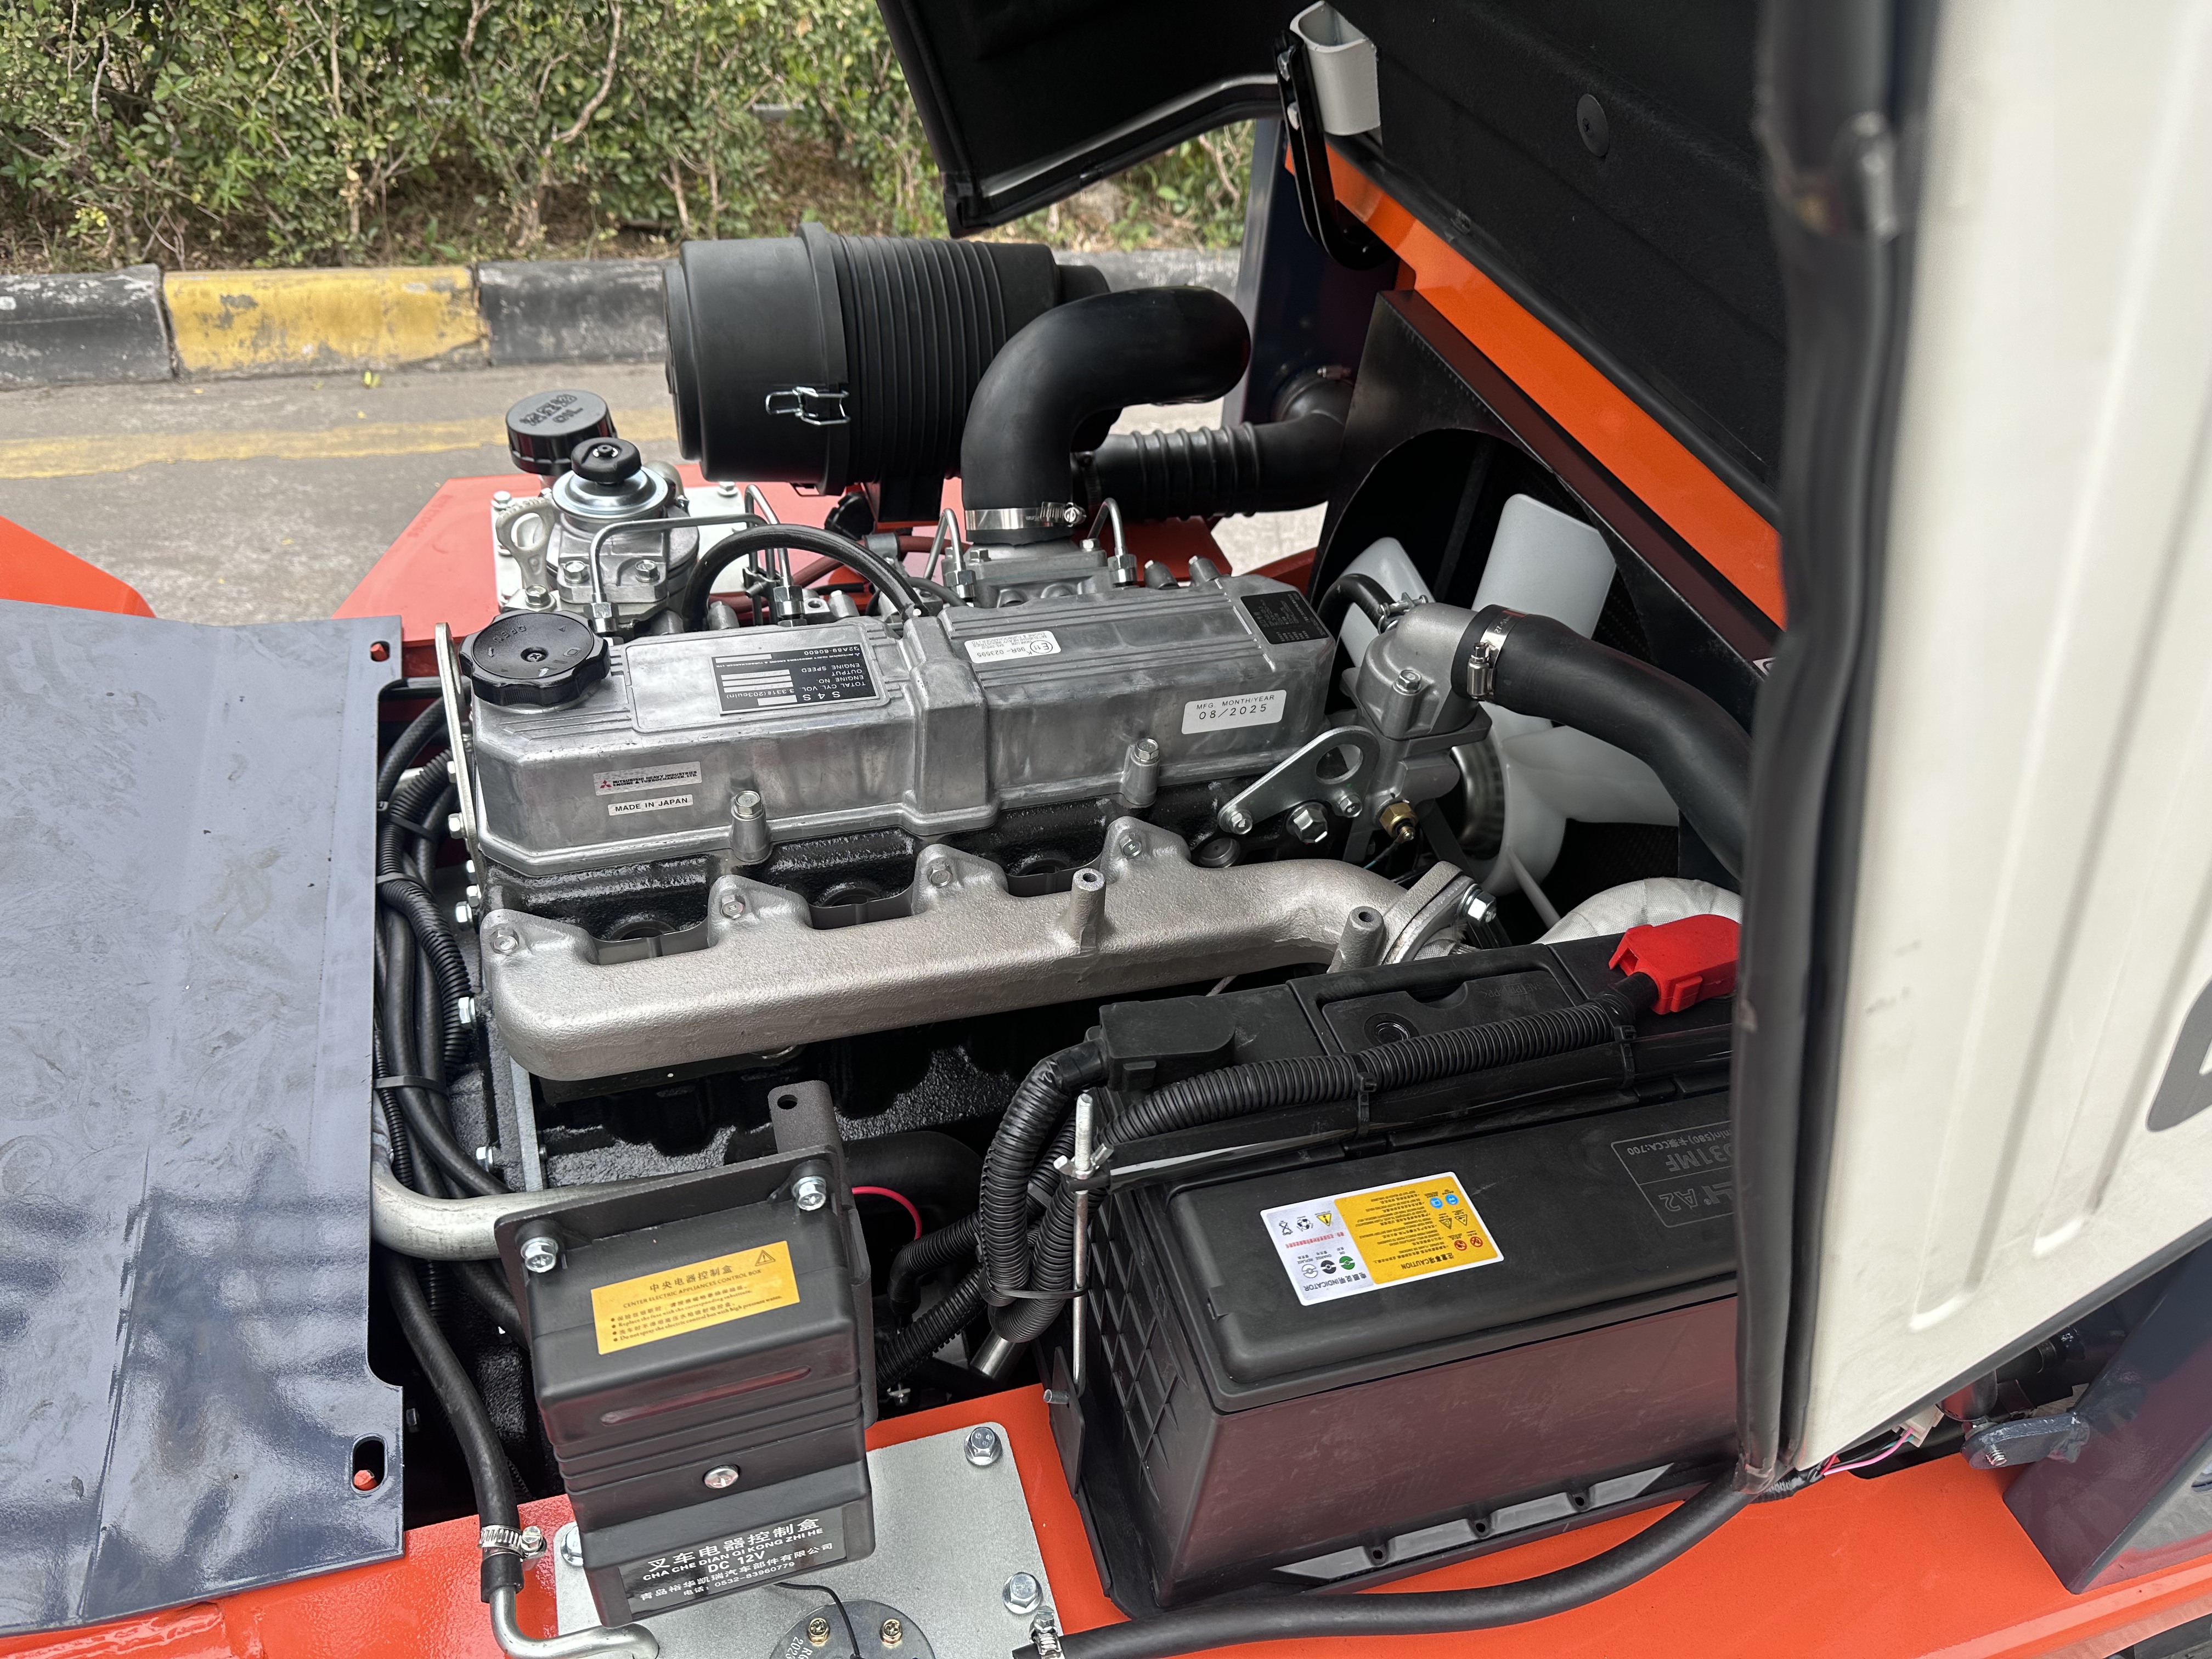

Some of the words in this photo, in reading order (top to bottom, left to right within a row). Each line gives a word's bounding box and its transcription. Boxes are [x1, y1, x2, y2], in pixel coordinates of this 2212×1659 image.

[552, 407, 583, 423] OIL
[493, 625, 527, 643] OPEN
[1199, 703, 1267, 720] 08/2025
[1222, 695, 1274, 707] MONTH/YEAR
[615, 803, 641, 812] MADE
[658, 797, 688, 806] JAPAN
[649, 1263, 732, 1293] 中央电器控制盒
[623, 1297, 647, 1308] CENTER
[648, 1290, 677, 1301] ELECTRIC
[678, 1280, 716, 1294] APPLIANCES
[717, 1272, 747, 1284] CONTROL
[643, 1568, 670, 1581] CHA
[673, 1562, 697, 1573] CHE
[698, 1554, 730, 1566] DIAN
[732, 1549, 746, 1558] QI
[748, 1538, 783, 1553] KONG
[786, 1532, 805, 1543] ZHI
[808, 1528, 823, 1537] HE
[647, 1518, 820, 1572] 叉车电器控制盒
[708, 1560, 730, 1573] DC
[738, 1550, 765, 1565] 12V
[714, 1561, 795, 1587] 0532-83960779
